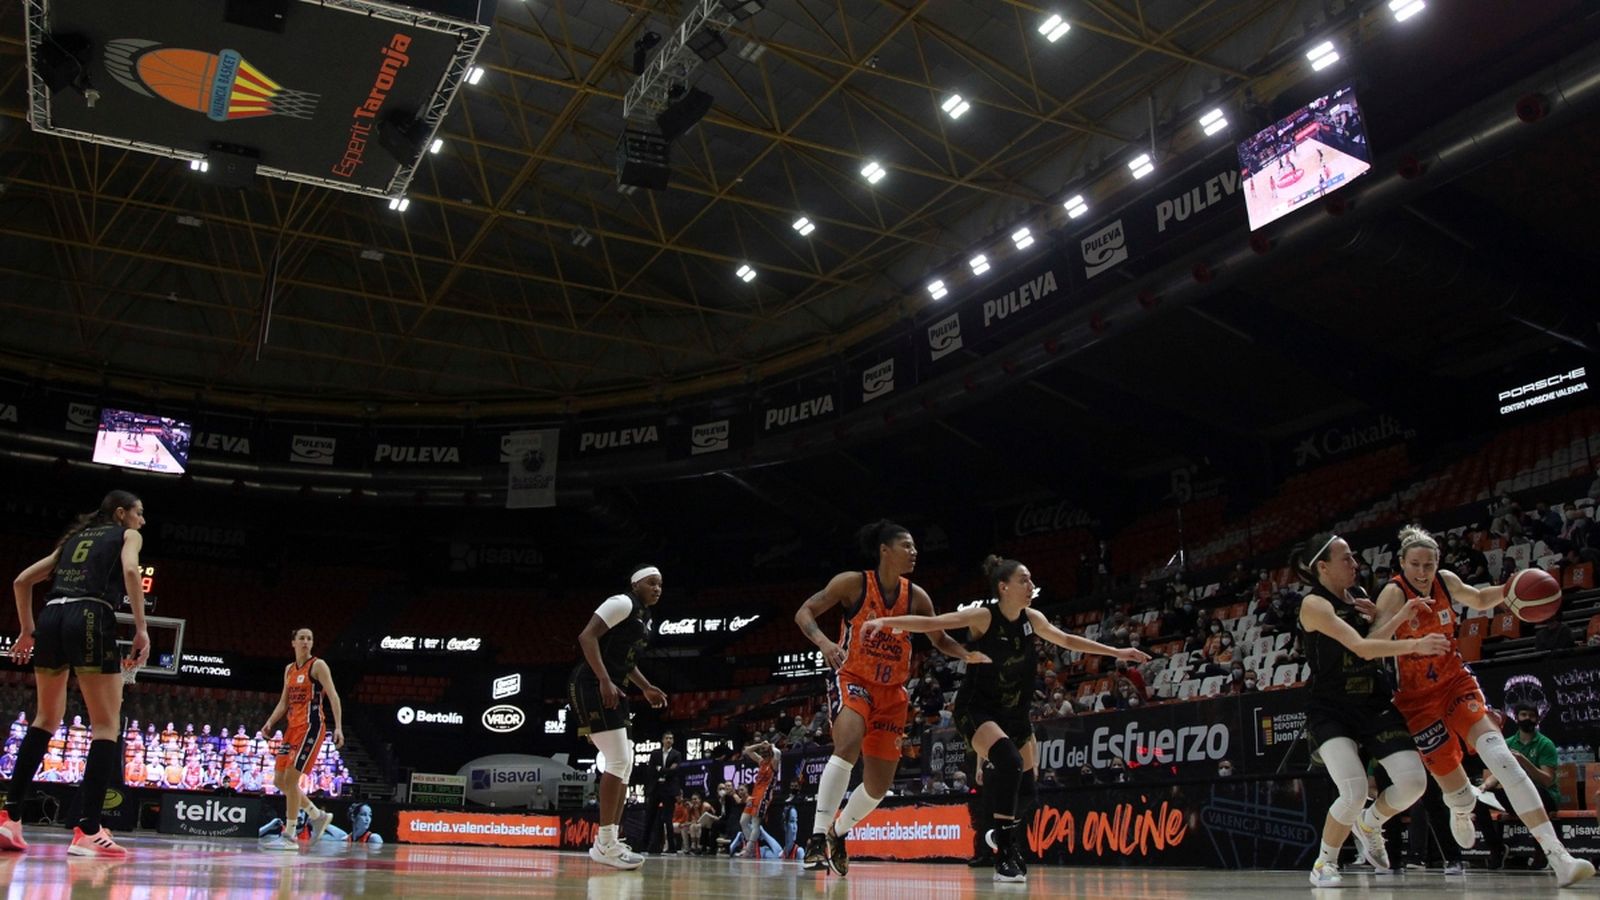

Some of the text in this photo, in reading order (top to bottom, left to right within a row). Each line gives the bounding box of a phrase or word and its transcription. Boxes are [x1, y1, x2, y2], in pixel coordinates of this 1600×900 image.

[212, 54, 237, 117] VALENCIA BASKET
[331, 32, 412, 177] Esperit Taronja
[1156, 169, 1243, 232] PULEV
[1084, 227, 1121, 254] PULEVA
[983, 270, 1058, 327] PULEVA
[930, 319, 958, 341] PULEVA
[865, 364, 892, 383] PULEVA
[1498, 367, 1586, 401] PORSCHE
[765, 393, 834, 430] PULEVA
[579, 425, 658, 451] PULEVA
[695, 425, 727, 437] PULEVA
[193, 431, 250, 455] LEVA
[295, 438, 333, 449] PULEVA
[374, 444, 459, 463] PULEVA
[72, 540, 94, 563] 6
[875, 664, 891, 683] 18
[1426, 662, 1438, 682] 4
[416, 710, 463, 724] Bertolín
[486, 713, 520, 725] VALOR
[1273, 732, 1293, 744] Juan
[1414, 723, 1444, 744] PULEVA
[1066, 745, 1089, 767] del
[1092, 721, 1230, 768] Esfuerzo
[493, 768, 541, 783] isaval
[562, 772, 588, 782] teika
[175, 799, 246, 824] teika
[189, 826, 208, 836] BUEN
[1264, 821, 1309, 842] BASKET
